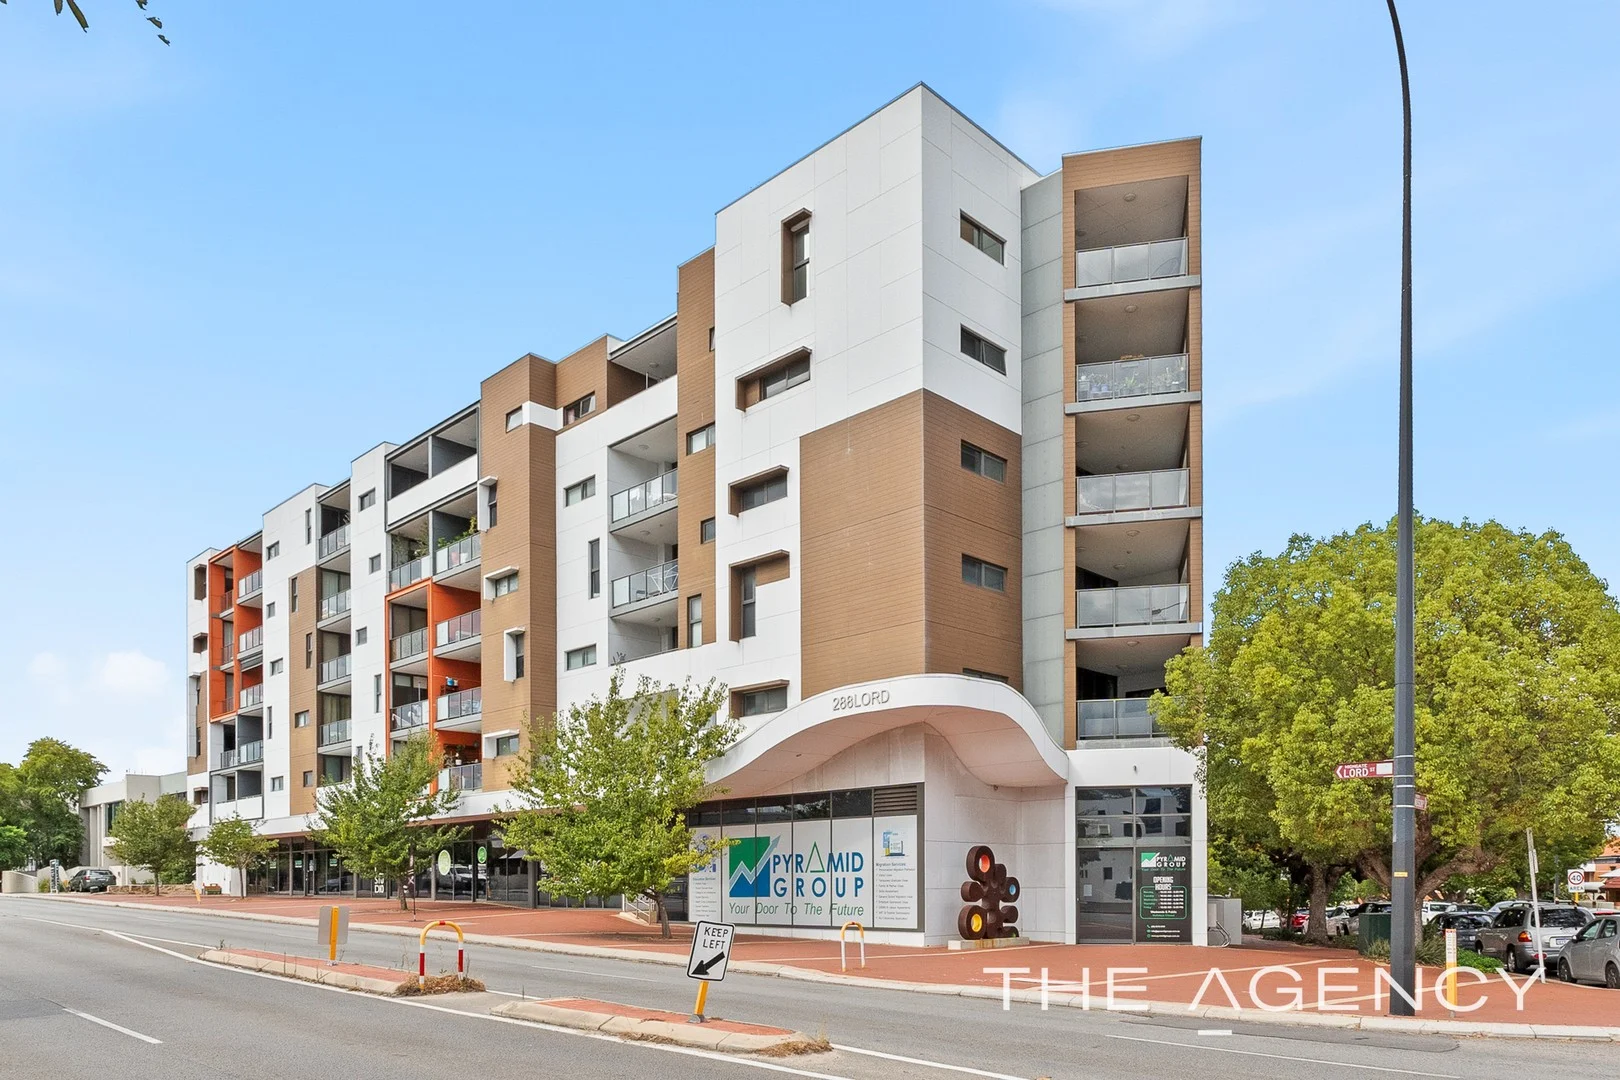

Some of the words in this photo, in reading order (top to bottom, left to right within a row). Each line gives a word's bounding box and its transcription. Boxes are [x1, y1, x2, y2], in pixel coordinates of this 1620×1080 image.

[1343, 768, 1369, 778] LORD
[772, 841, 864, 874] PYRAMID
[1156, 854, 1186, 862] PYRAMID
[1571, 874, 1582, 882] 40
[773, 876, 865, 898] GROUP
[1155, 883, 1172, 891] HOURS
[729, 902, 750, 915] Your
[756, 902, 779, 915] Door
[785, 902, 798, 915] To
[804, 902, 823, 916] The
[829, 902, 865, 916] Future
[704, 926, 729, 938] KEEP
[702, 938, 726, 950] LEFT
